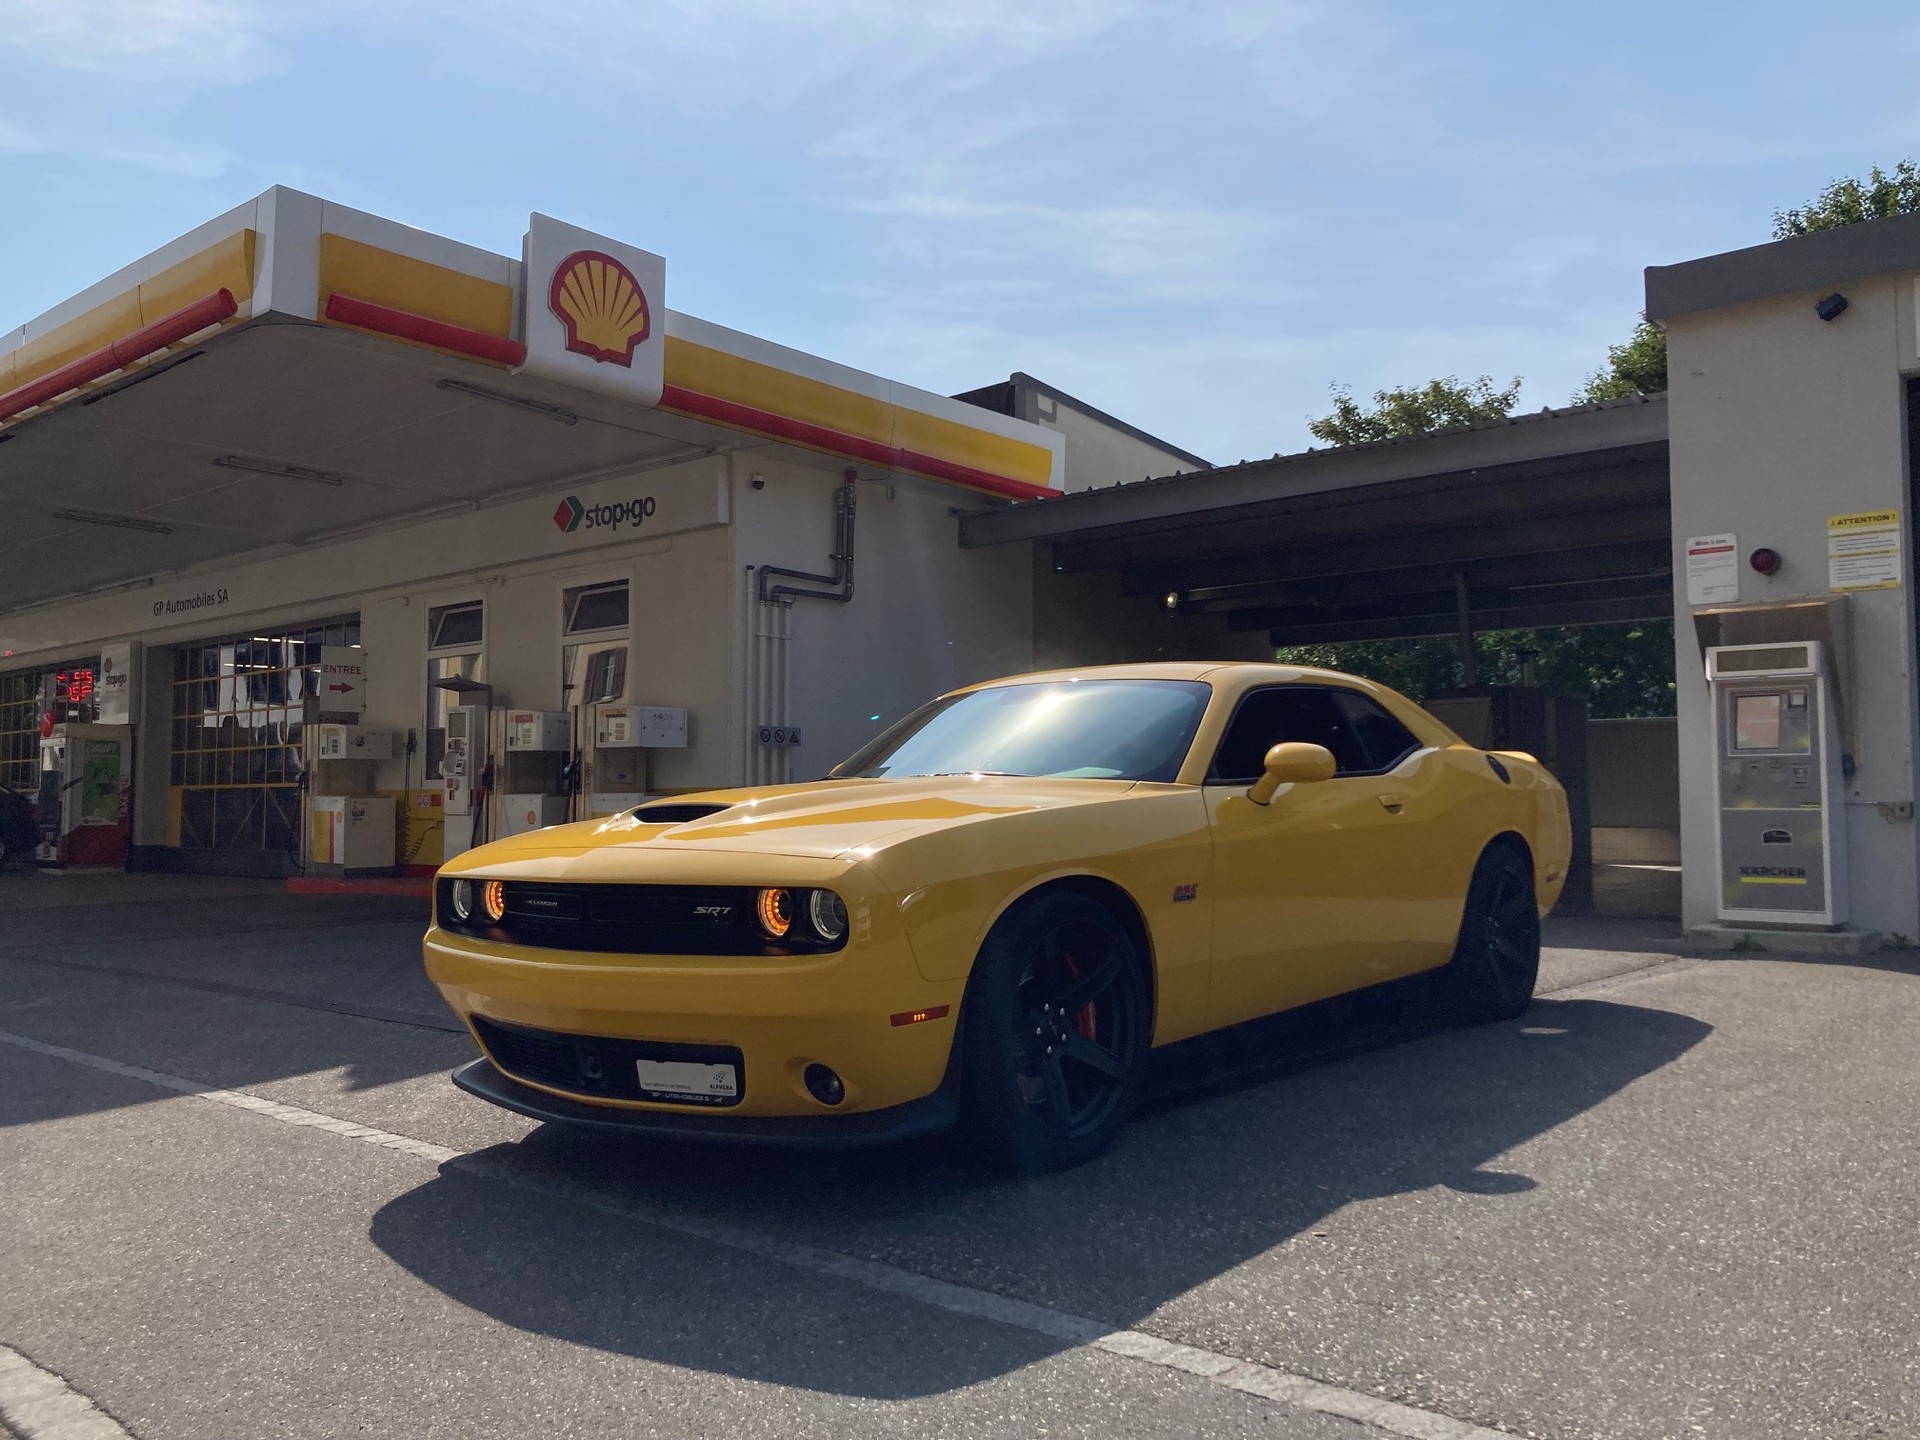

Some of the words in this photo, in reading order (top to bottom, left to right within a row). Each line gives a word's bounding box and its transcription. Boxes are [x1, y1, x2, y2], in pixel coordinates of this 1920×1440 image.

[1837, 514, 1890, 526] ATTENTION
[153, 601, 164, 616] GP
[165, 591, 215, 615] Automobiles
[217, 588, 229, 604] SA
[693, 906, 732, 916] SRT
[662, 1092, 705, 1102] UTOMOBILES
